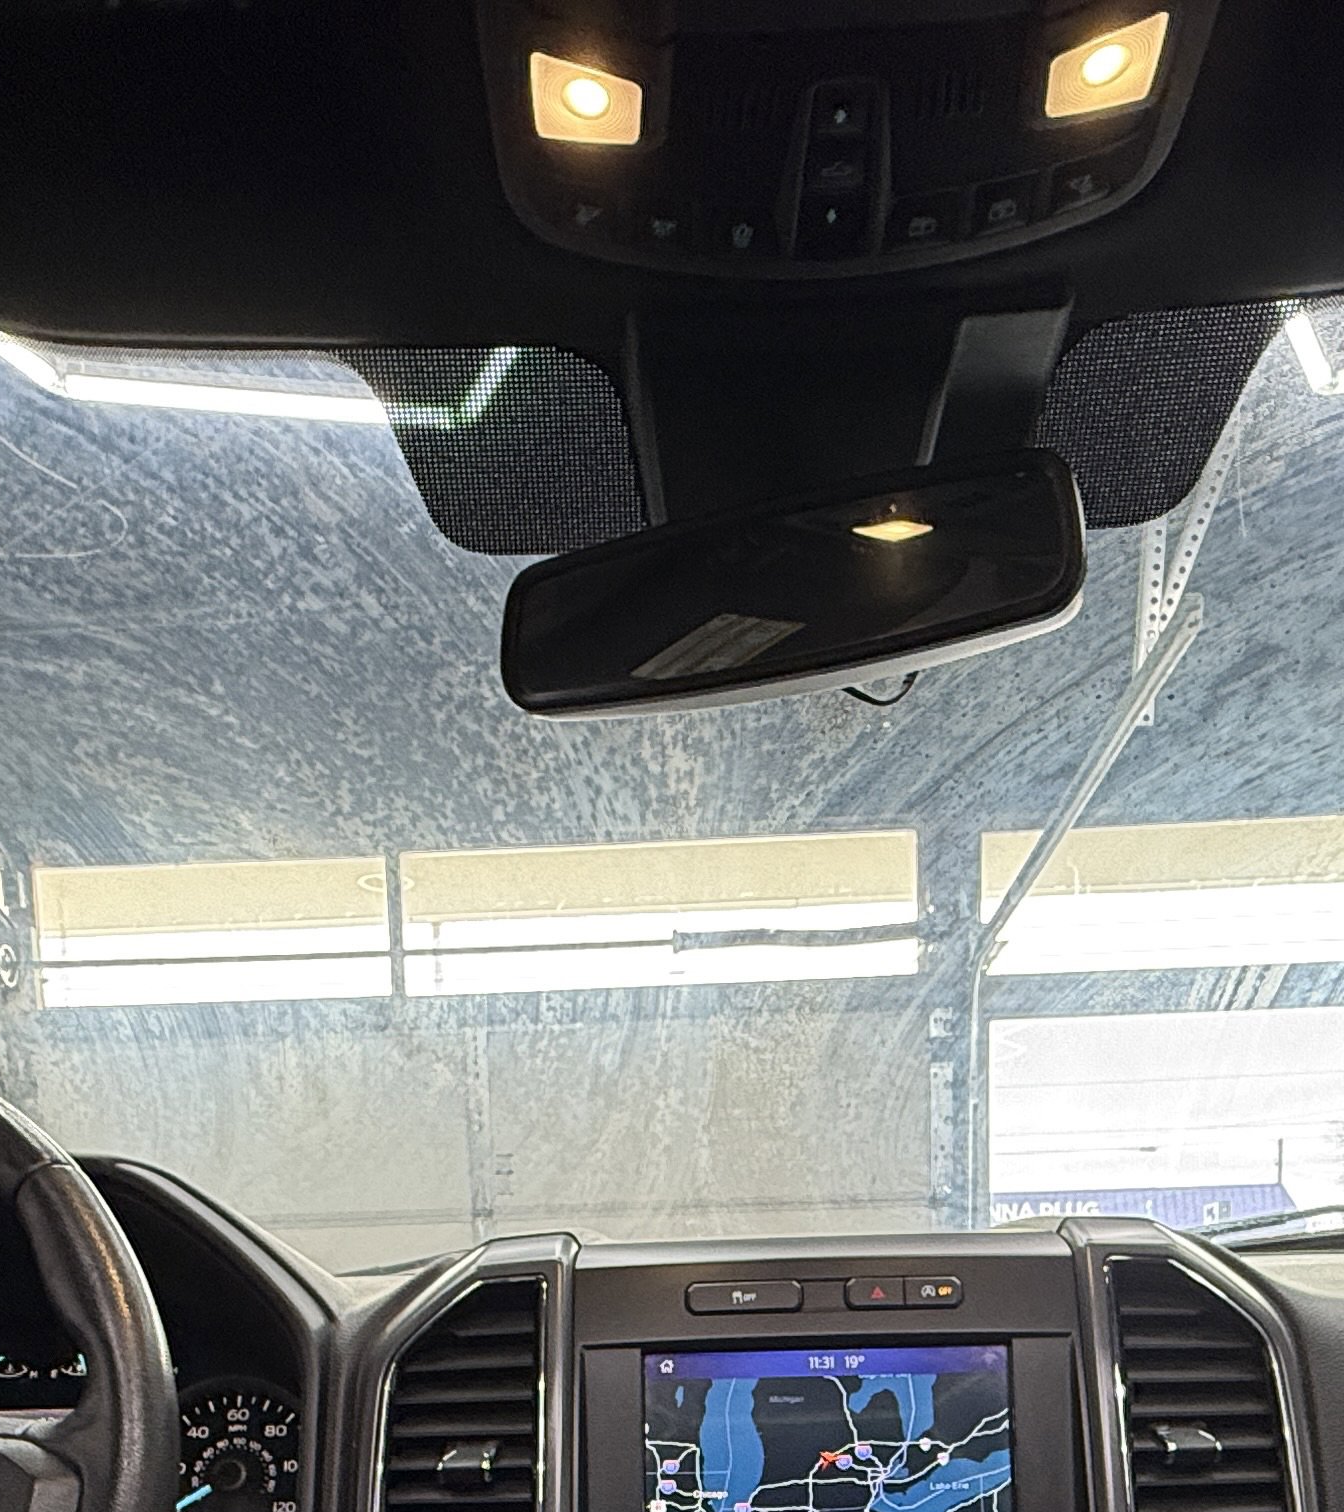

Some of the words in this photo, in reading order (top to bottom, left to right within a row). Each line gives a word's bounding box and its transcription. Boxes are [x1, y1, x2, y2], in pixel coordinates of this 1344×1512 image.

[809, 1356, 835, 1369] 11:31
[227, 1408, 250, 1421] 60
[187, 1426, 209, 1438] 40
[228, 1424, 247, 1432] MPH
[264, 1425, 287, 1437] 80
